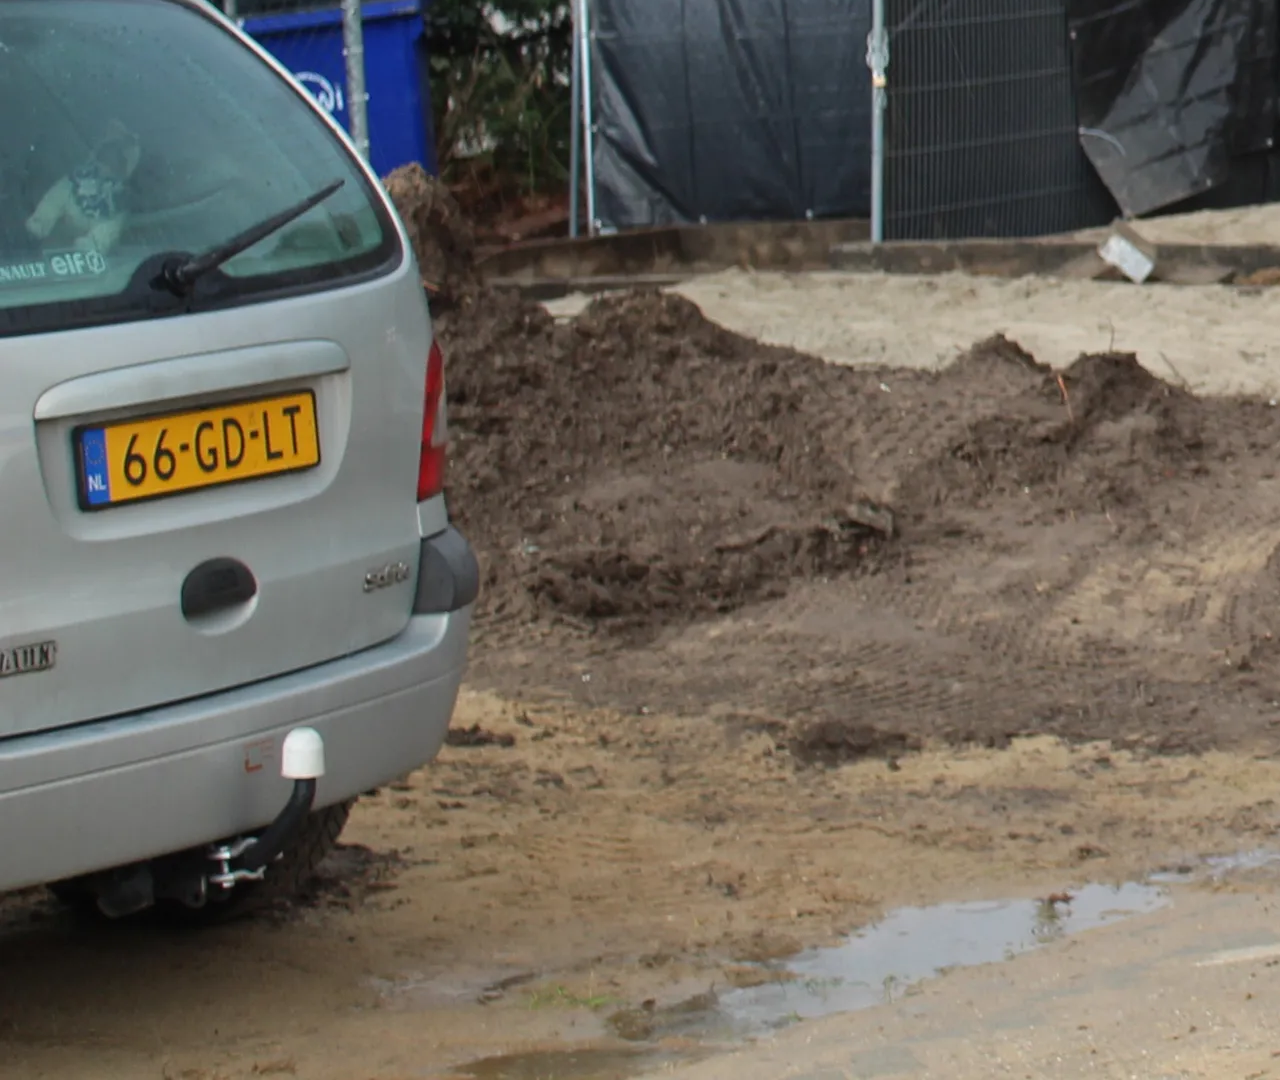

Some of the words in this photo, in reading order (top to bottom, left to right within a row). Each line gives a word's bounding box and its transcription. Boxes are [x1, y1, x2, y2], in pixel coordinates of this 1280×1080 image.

[50, 251, 86, 276] elf
[122, 404, 301, 486] 66-GD-LT
[88, 473, 107, 492] NL
